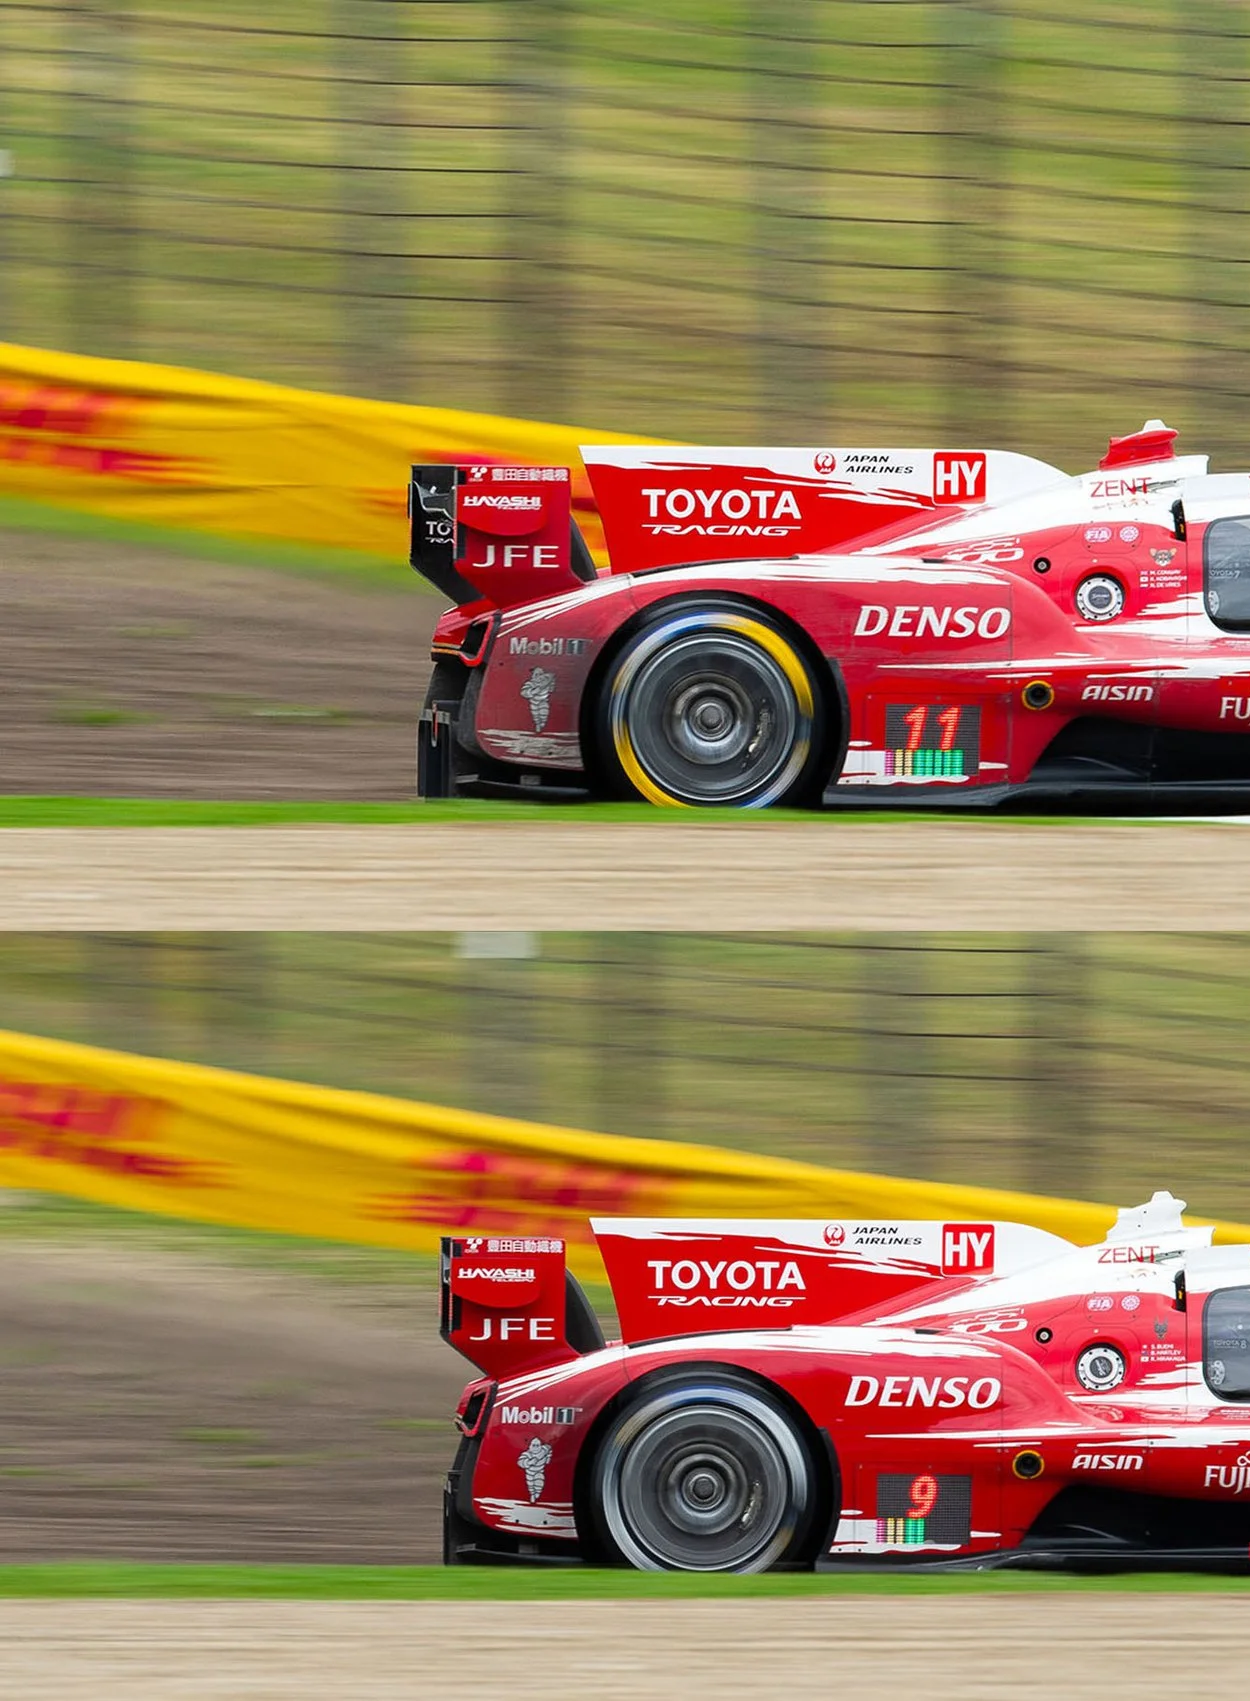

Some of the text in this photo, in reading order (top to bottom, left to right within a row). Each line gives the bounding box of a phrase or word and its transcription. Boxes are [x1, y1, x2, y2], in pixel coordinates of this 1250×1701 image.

[843, 455, 890, 463] JAPAN
[846, 466, 914, 474] AIRLINES
[935, 460, 984, 496] HY
[1090, 477, 1153, 498] ZENT
[463, 495, 543, 507] HAYASHI
[641, 488, 803, 519] TOYOTA
[641, 524, 802, 537] RACING
[472, 545, 560, 568] JFE
[854, 605, 1012, 639] DENSO
[509, 637, 564, 656] Mobil
[1081, 684, 1155, 702] AISIN
[903, 705, 963, 752] 11
[852, 1226, 899, 1235] JAPAN
[854, 1237, 922, 1246] AIRLINES
[944, 1231, 992, 1268] HY
[1097, 1246, 1160, 1264] ZENT
[457, 1268, 537, 1280] HAYASHI
[647, 1259, 807, 1290] TOYOTA
[647, 1295, 807, 1308] RACING
[469, 1318, 556, 1341] JFE
[844, 1375, 1001, 1409] DENSO
[501, 1407, 554, 1424] Mobil
[1072, 1454, 1144, 1470] AISIN
[906, 1474, 938, 1520] 9
